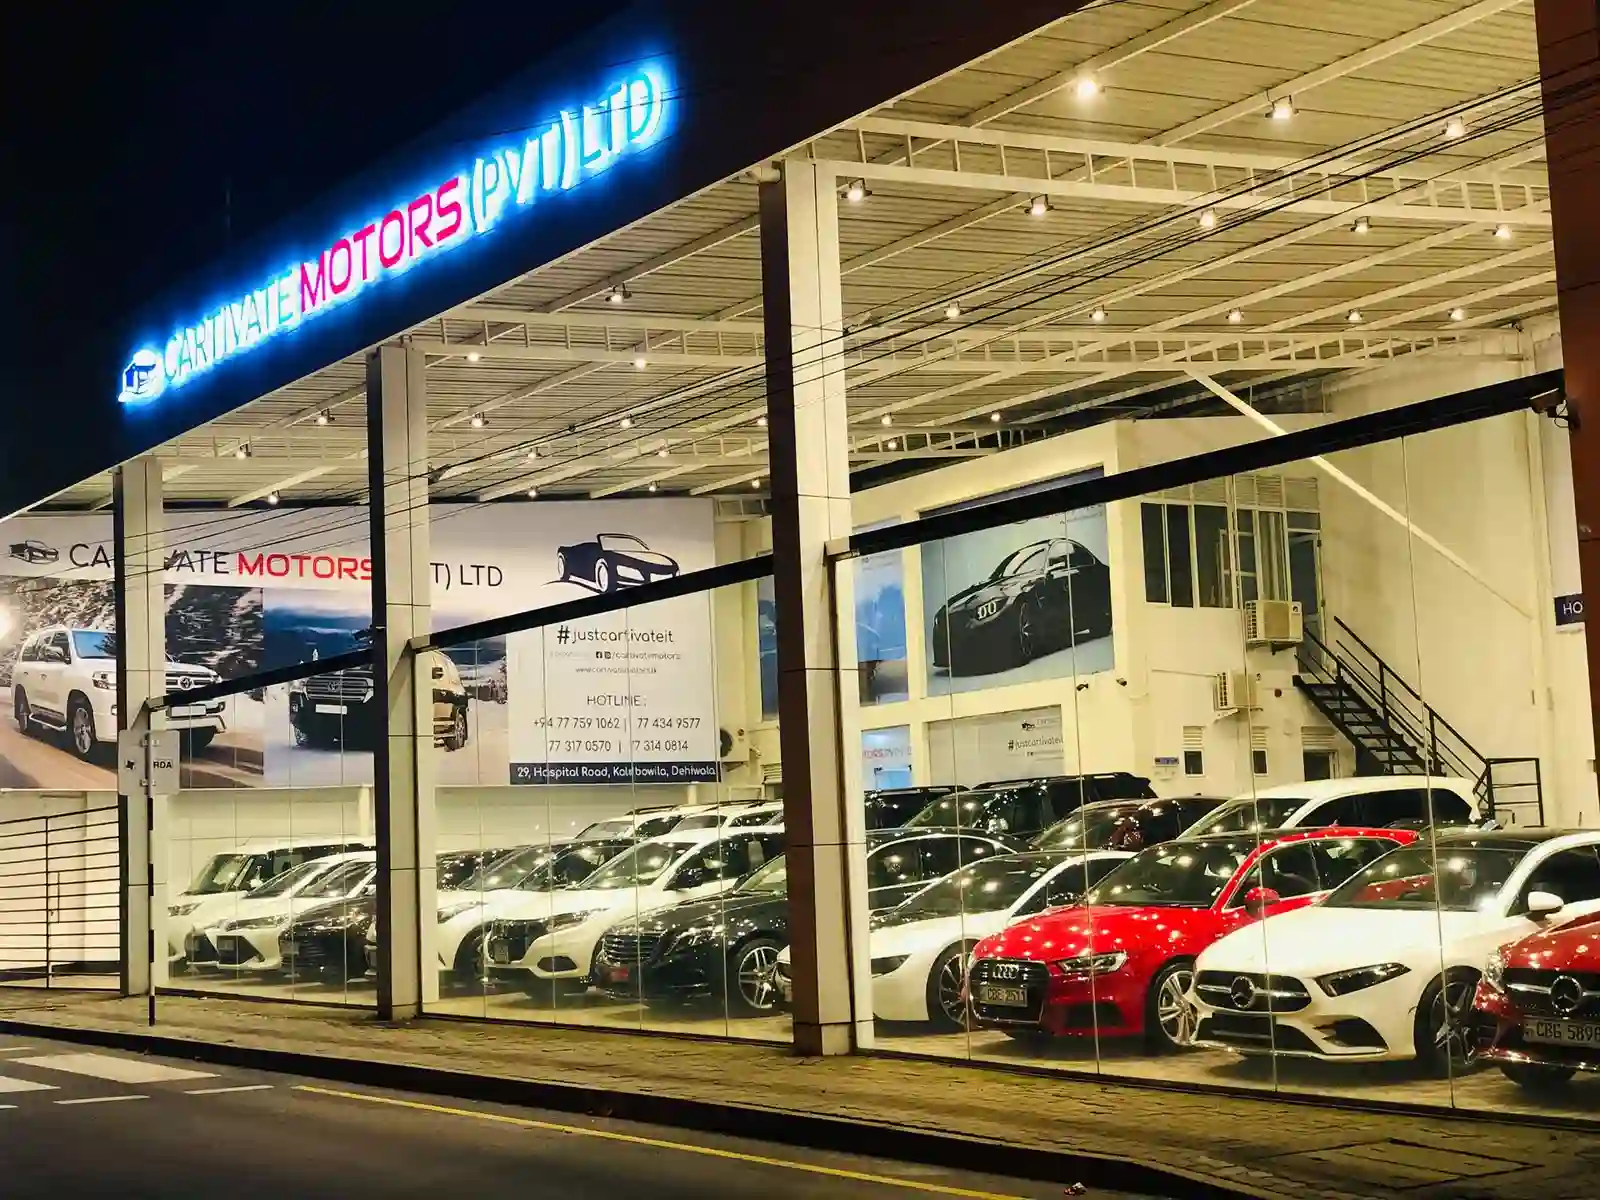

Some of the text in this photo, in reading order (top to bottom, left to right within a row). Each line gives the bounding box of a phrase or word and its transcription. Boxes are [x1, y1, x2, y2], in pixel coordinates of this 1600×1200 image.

[164, 268, 296, 384] CARTIVATE
[300, 177, 462, 313] MOTORS
[580, 73, 657, 166] LTD
[460, 564, 503, 587] LTD
[534, 717, 553, 729] +94
[557, 717, 569, 729] 77
[574, 717, 592, 729] 759
[597, 717, 620, 729] 1062
[637, 717, 649, 729] 77
[652, 717, 672, 729] 434
[677, 717, 701, 729] 9577
[549, 740, 561, 752] 77
[565, 740, 581, 752] 317
[585, 740, 611, 752] 0570
[643, 740, 661, 751] 314
[665, 740, 688, 751] 0814
[153, 761, 172, 769] RDA
[517, 766, 531, 779] 29,
[533, 766, 579, 780] Hospital
[581, 766, 611, 779] Road,
[672, 765, 716, 776] Dehiwala
